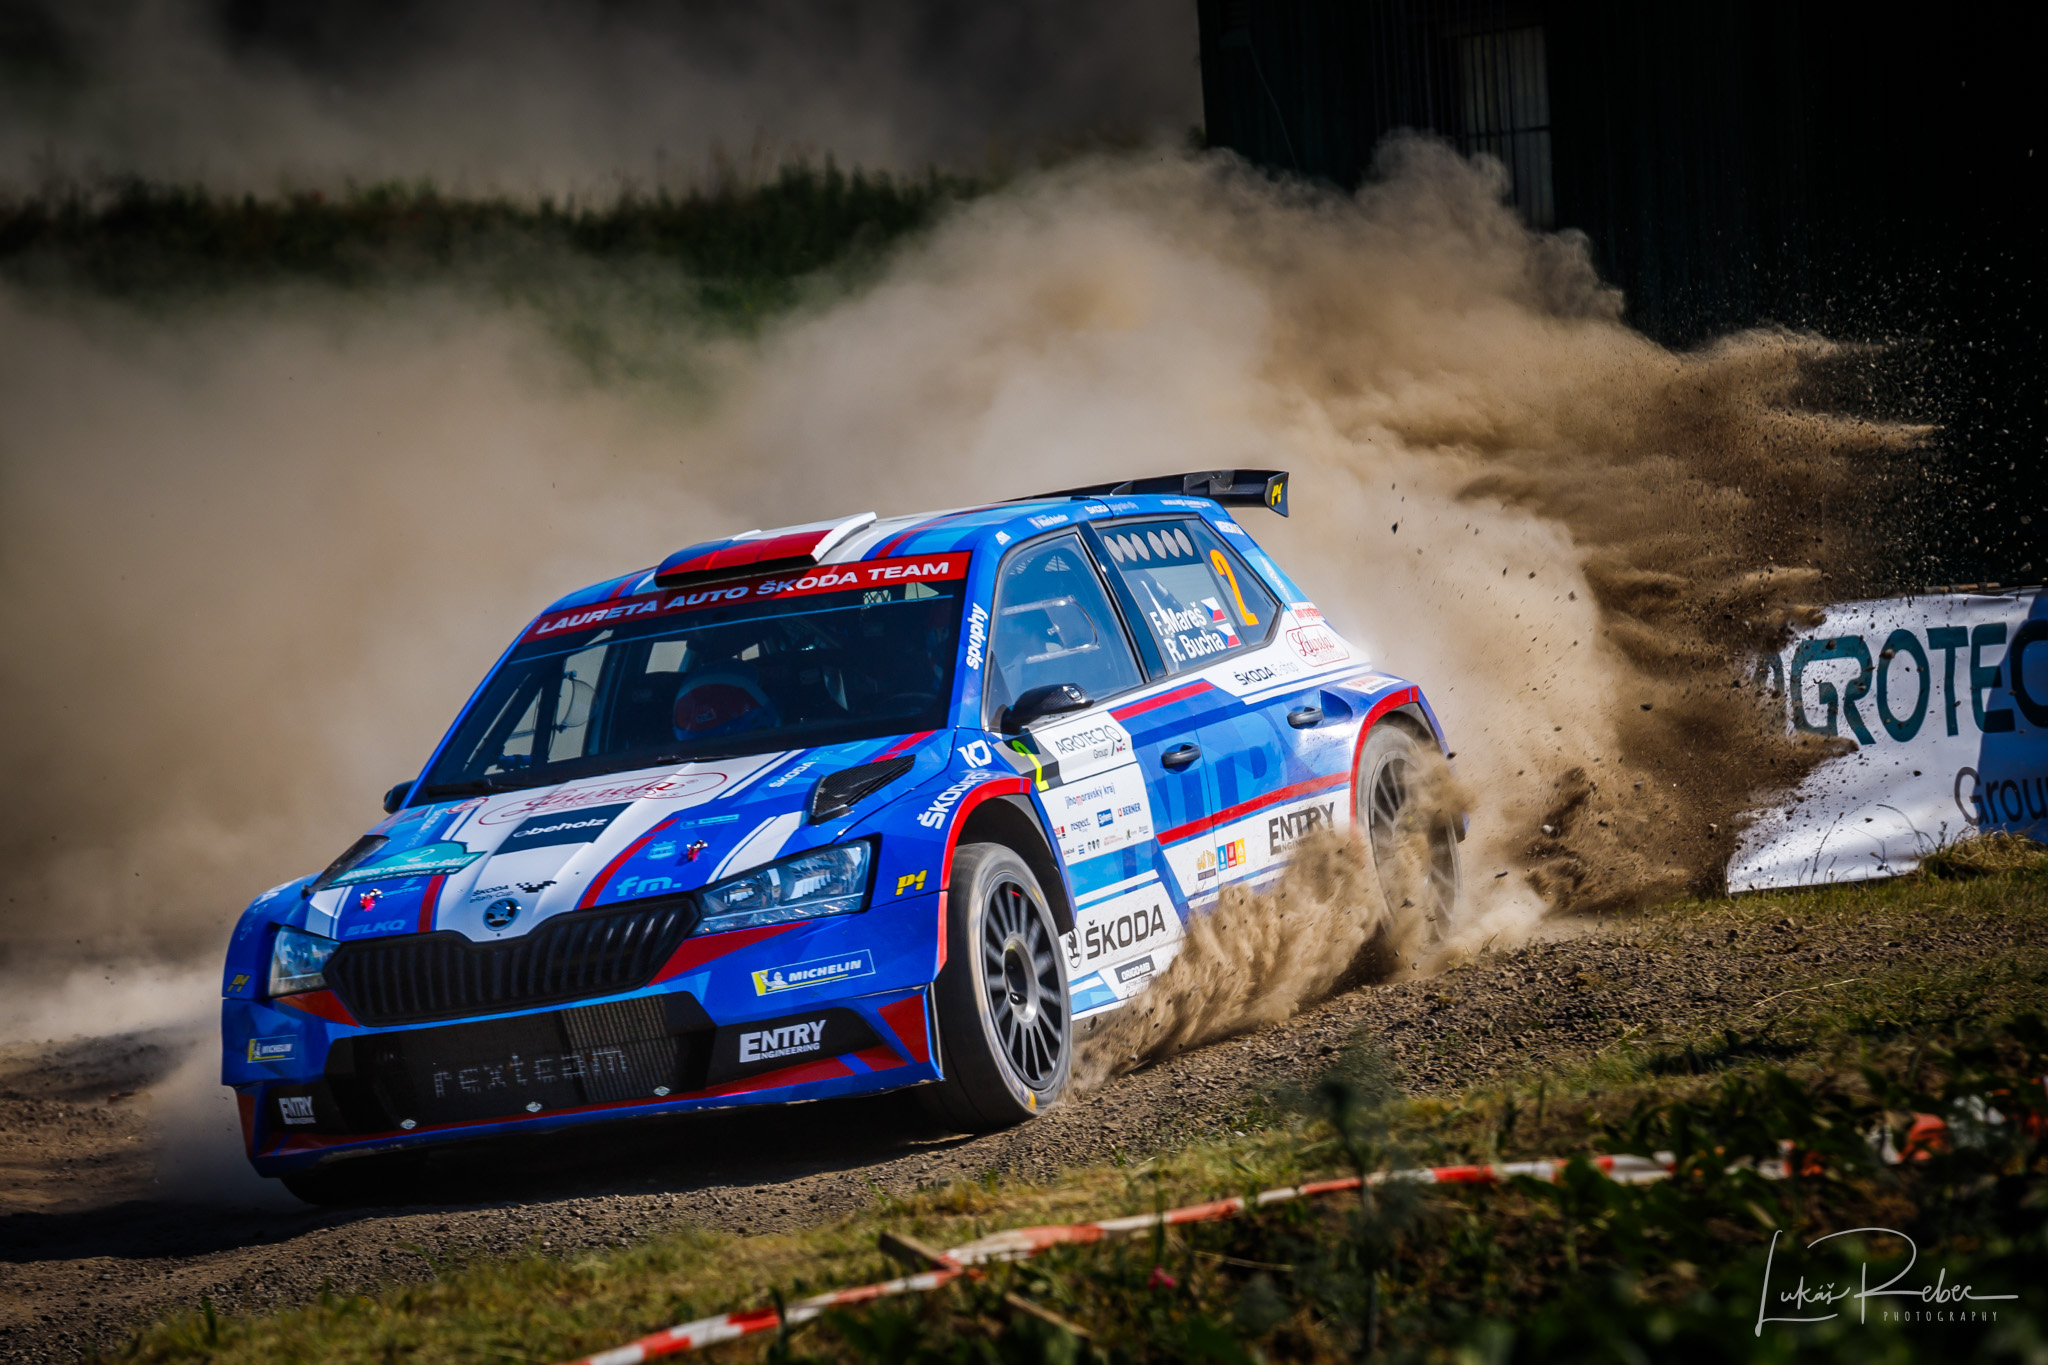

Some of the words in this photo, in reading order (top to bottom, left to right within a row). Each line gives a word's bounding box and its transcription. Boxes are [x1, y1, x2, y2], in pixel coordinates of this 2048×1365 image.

[536, 600, 657, 635] LAURETA
[664, 586, 749, 611] AUTO
[756, 571, 858, 595] ŠKODA
[868, 561, 949, 581] TEAM
[1209, 548, 1260, 627] 2
[1179, 629, 1227, 660] Bucha
[1234, 666, 1276, 686] ŠKODA
[1055, 729, 1106, 755] AGROTEC
[1093, 748, 1109, 759] Group
[768, 760, 816, 789] ŠKODA
[1011, 739, 1050, 793] 2
[1102, 781, 1116, 795] kraj
[1953, 766, 2048, 826] Grou
[1122, 802, 1142, 817] BERNER
[1268, 801, 1335, 857] ENTRY
[616, 875, 682, 897] fm.
[1085, 903, 1166, 961] ŠKODA
[788, 959, 862, 983] MICHELIN
[738, 1019, 827, 1064] ENTRY
[433, 1049, 628, 1098] rexteam
[278, 1096, 315, 1125] ENTRY
